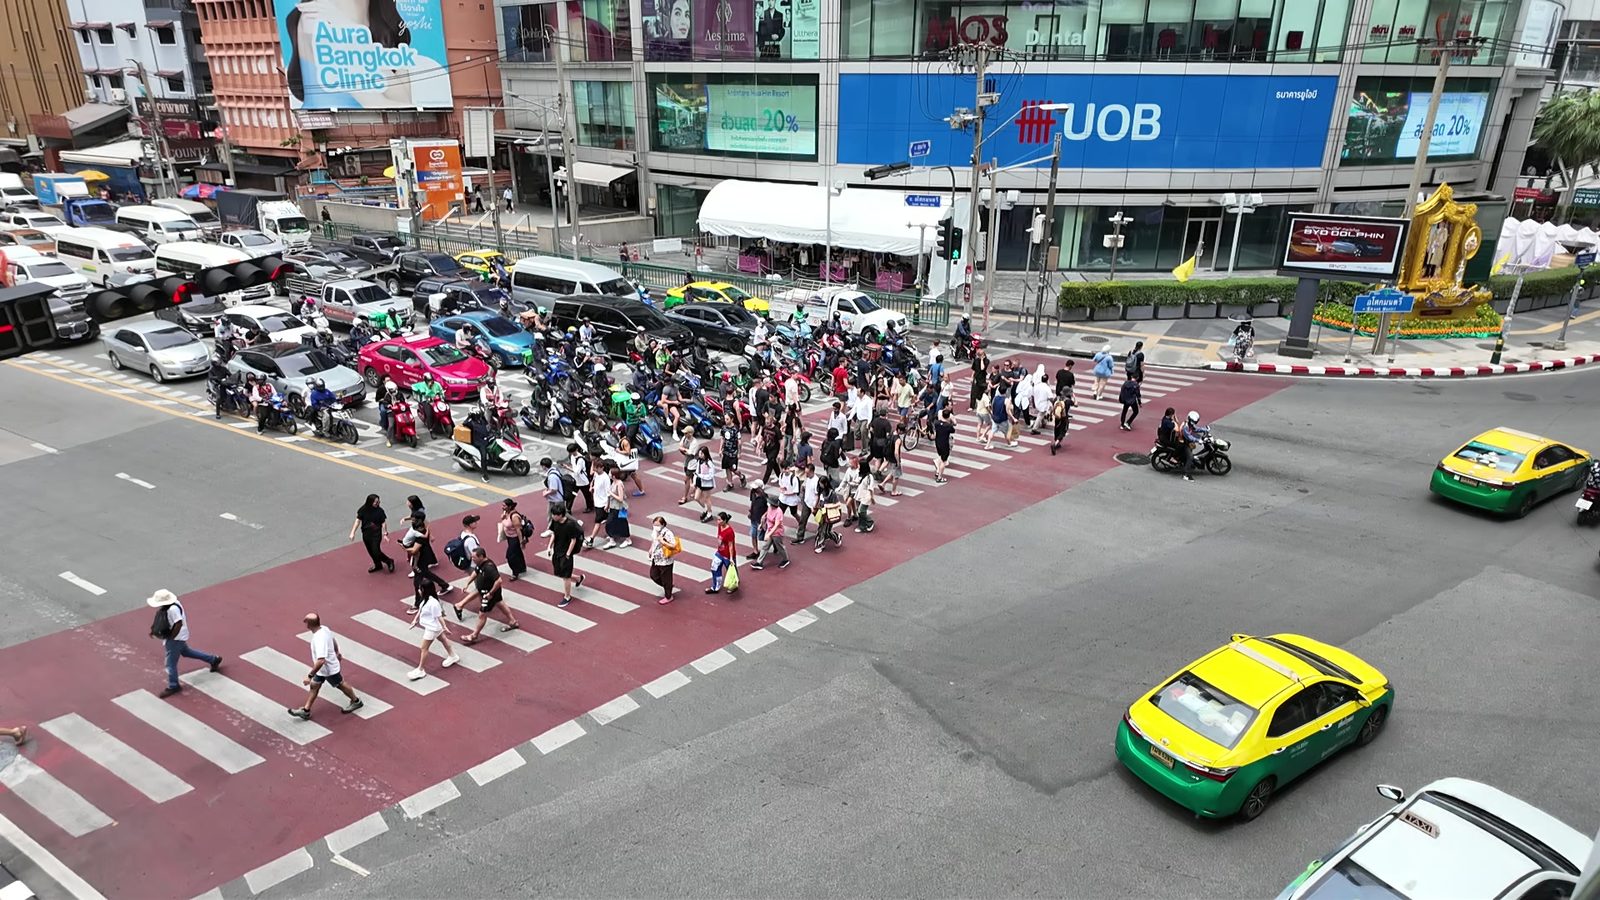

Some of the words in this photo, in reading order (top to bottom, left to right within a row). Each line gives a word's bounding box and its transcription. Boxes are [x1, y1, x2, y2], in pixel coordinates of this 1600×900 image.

[315, 21, 369, 45] Aura
[925, 14, 1009, 48] MOS
[1025, 28, 1087, 47] Dental
[316, 44, 416, 73] Bangkok
[320, 66, 385, 91] Clinic
[1275, 89, 1318, 102] ธนาคารยูโอบี
[156, 103, 189, 114] COWBOY
[762, 108, 799, 133] 20%
[1062, 102, 1161, 142] UOB
[1446, 114, 1472, 136] 20%
[1303, 228, 1329, 236] BYD
[1330, 230, 1385, 240] DOLPHIN
[1366, 296, 1403, 306] อโศกมนตรี
[1404, 814, 1433, 833] TAXI
